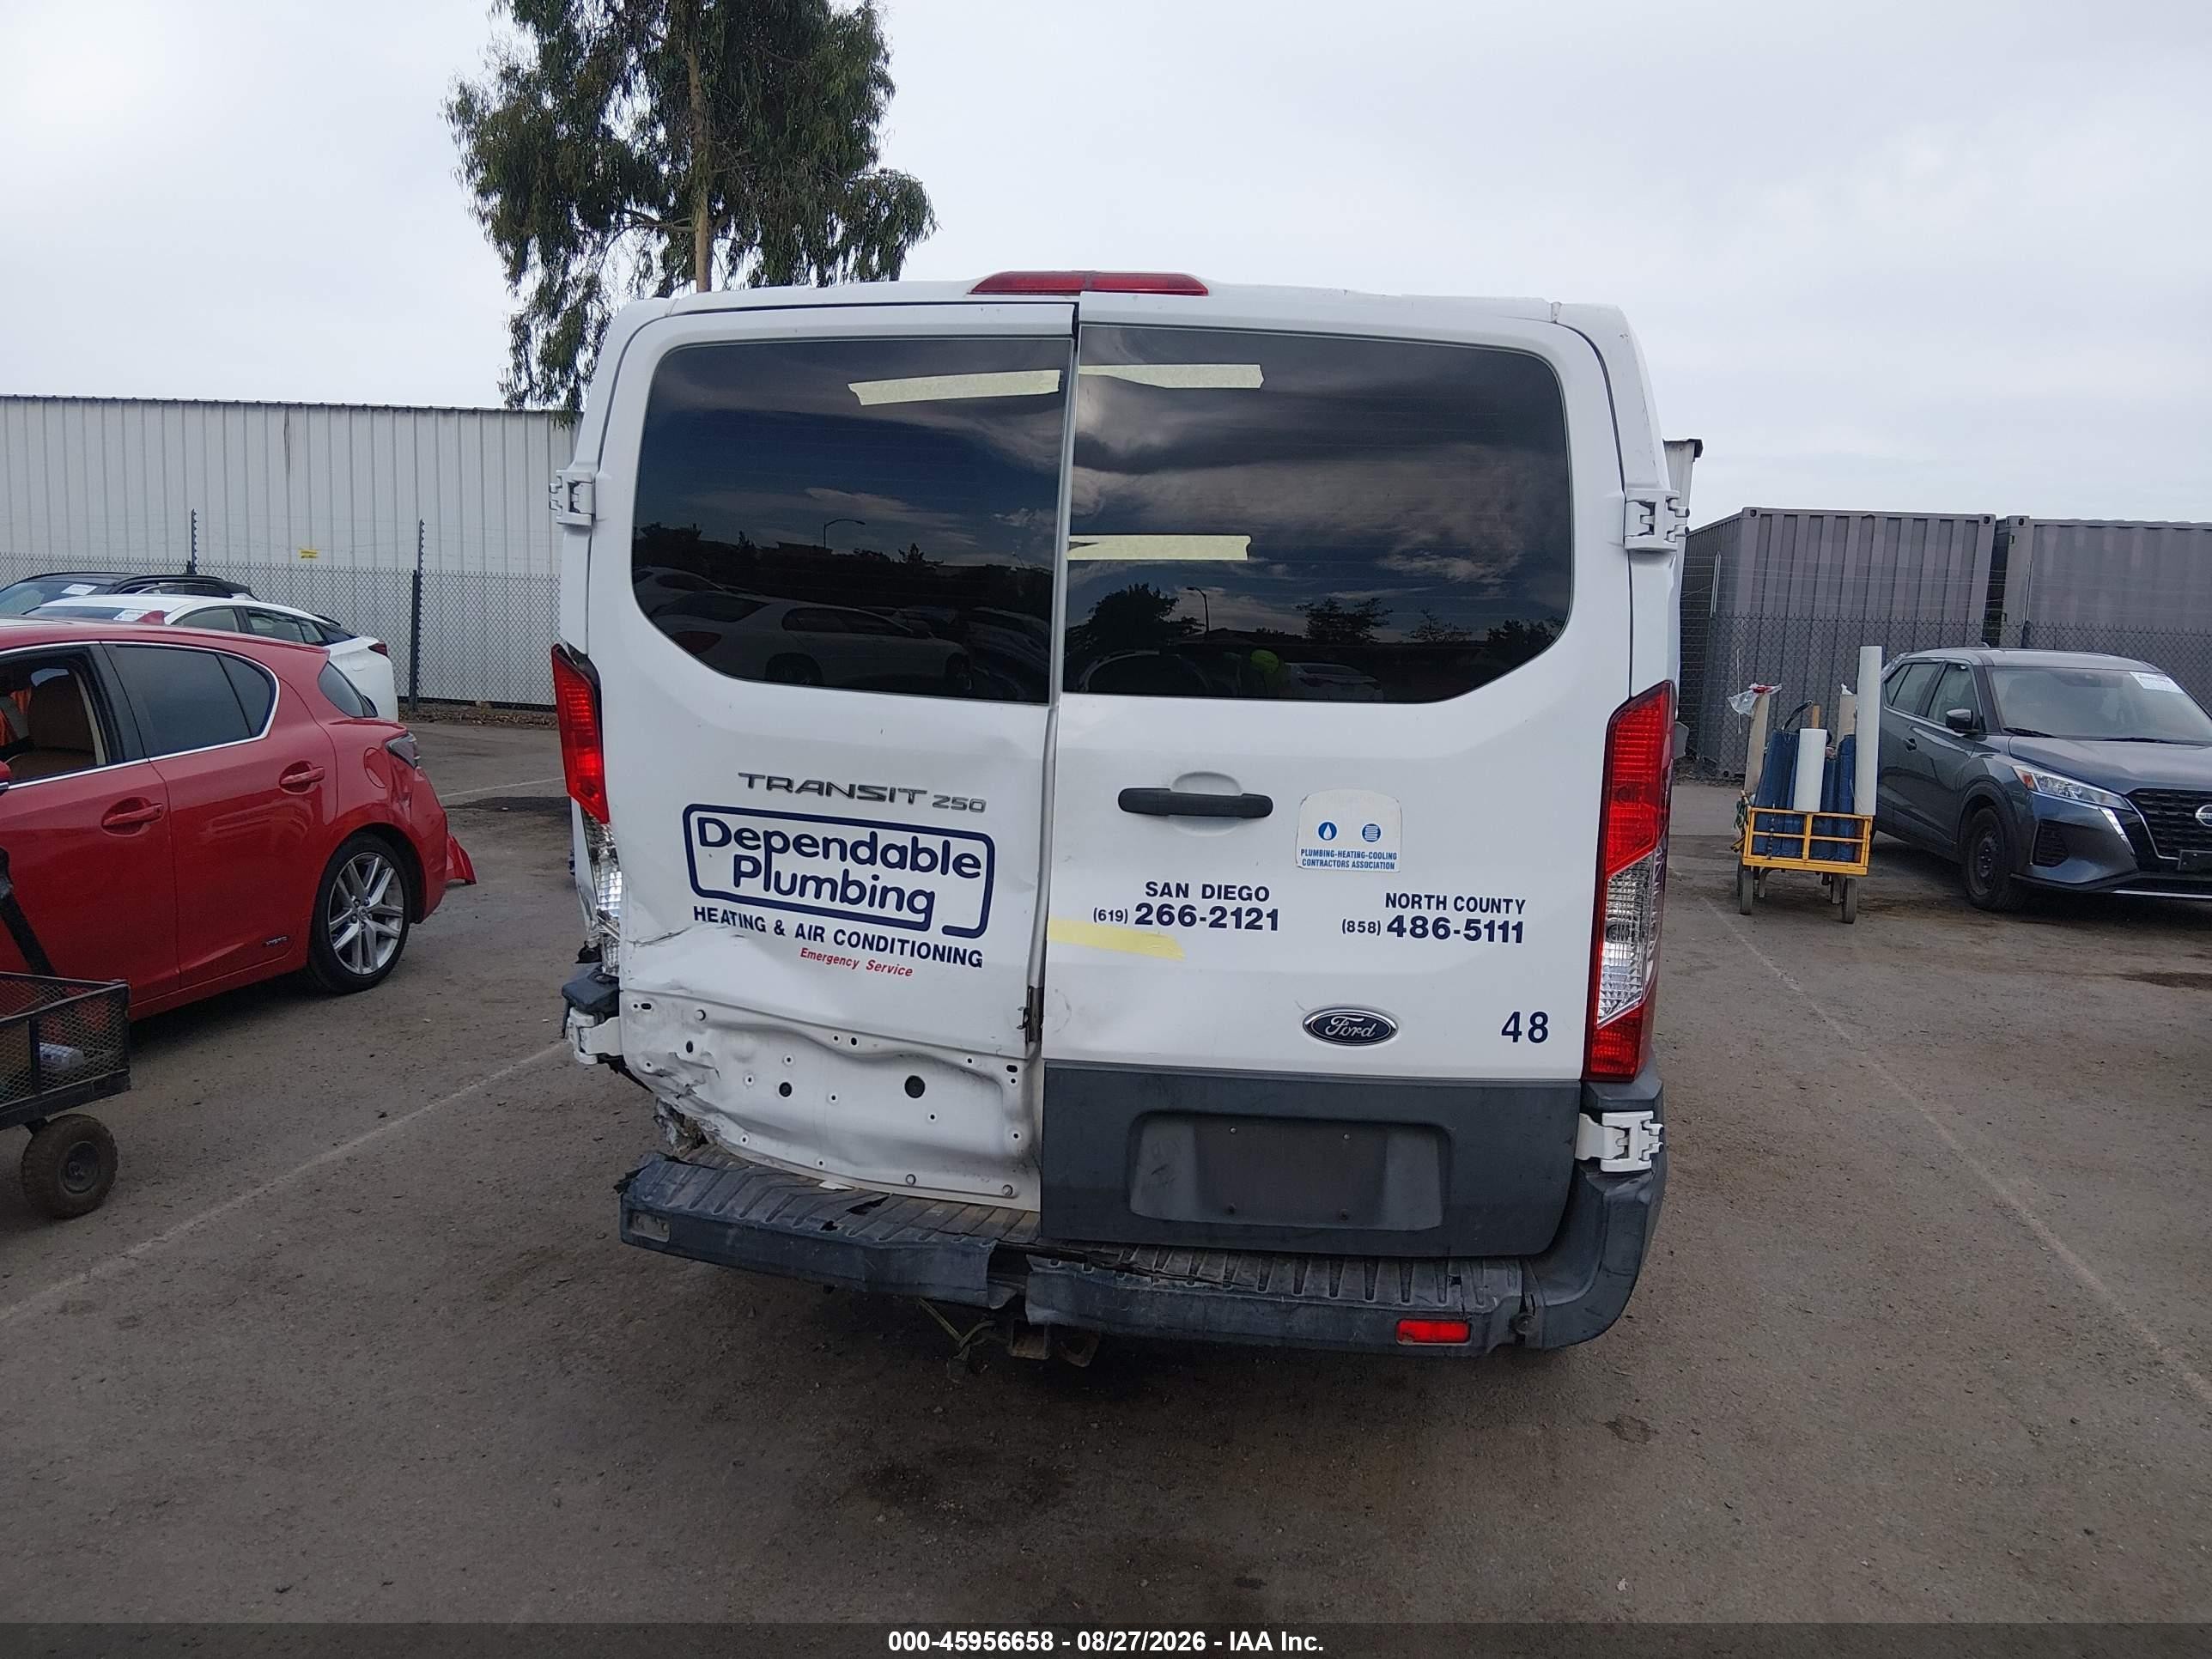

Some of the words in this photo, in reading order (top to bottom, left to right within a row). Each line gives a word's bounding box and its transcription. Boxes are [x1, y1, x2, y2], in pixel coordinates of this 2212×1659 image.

[738, 772, 928, 805] TRANSIT
[933, 793, 987, 812] 250
[697, 817, 982, 892] Dependable
[1302, 859, 1350, 868] CONTRACTORS
[1352, 860, 1395, 870] ASSOCIATION
[732, 854, 936, 928] Plumbing
[1145, 881, 1189, 899] SAN
[1201, 884, 1270, 902] DIEGO
[1385, 892, 1448, 912] NORTH
[1453, 896, 1526, 916] COUNTY
[1092, 907, 1128, 924] (619)
[1134, 902, 1279, 932] 266-2121
[1341, 918, 1382, 935] (858)
[1387, 915, 1524, 944] 486-5111
[693, 905, 767, 933] HEATING
[774, 920, 786, 936] &
[794, 922, 825, 943] AIR
[833, 928, 983, 969] CONDITIONING
[799, 947, 860, 970] Emergency
[866, 959, 914, 977] Service
[1324, 1013, 1376, 1040] Ford
[1501, 1012, 1549, 1044] 48
